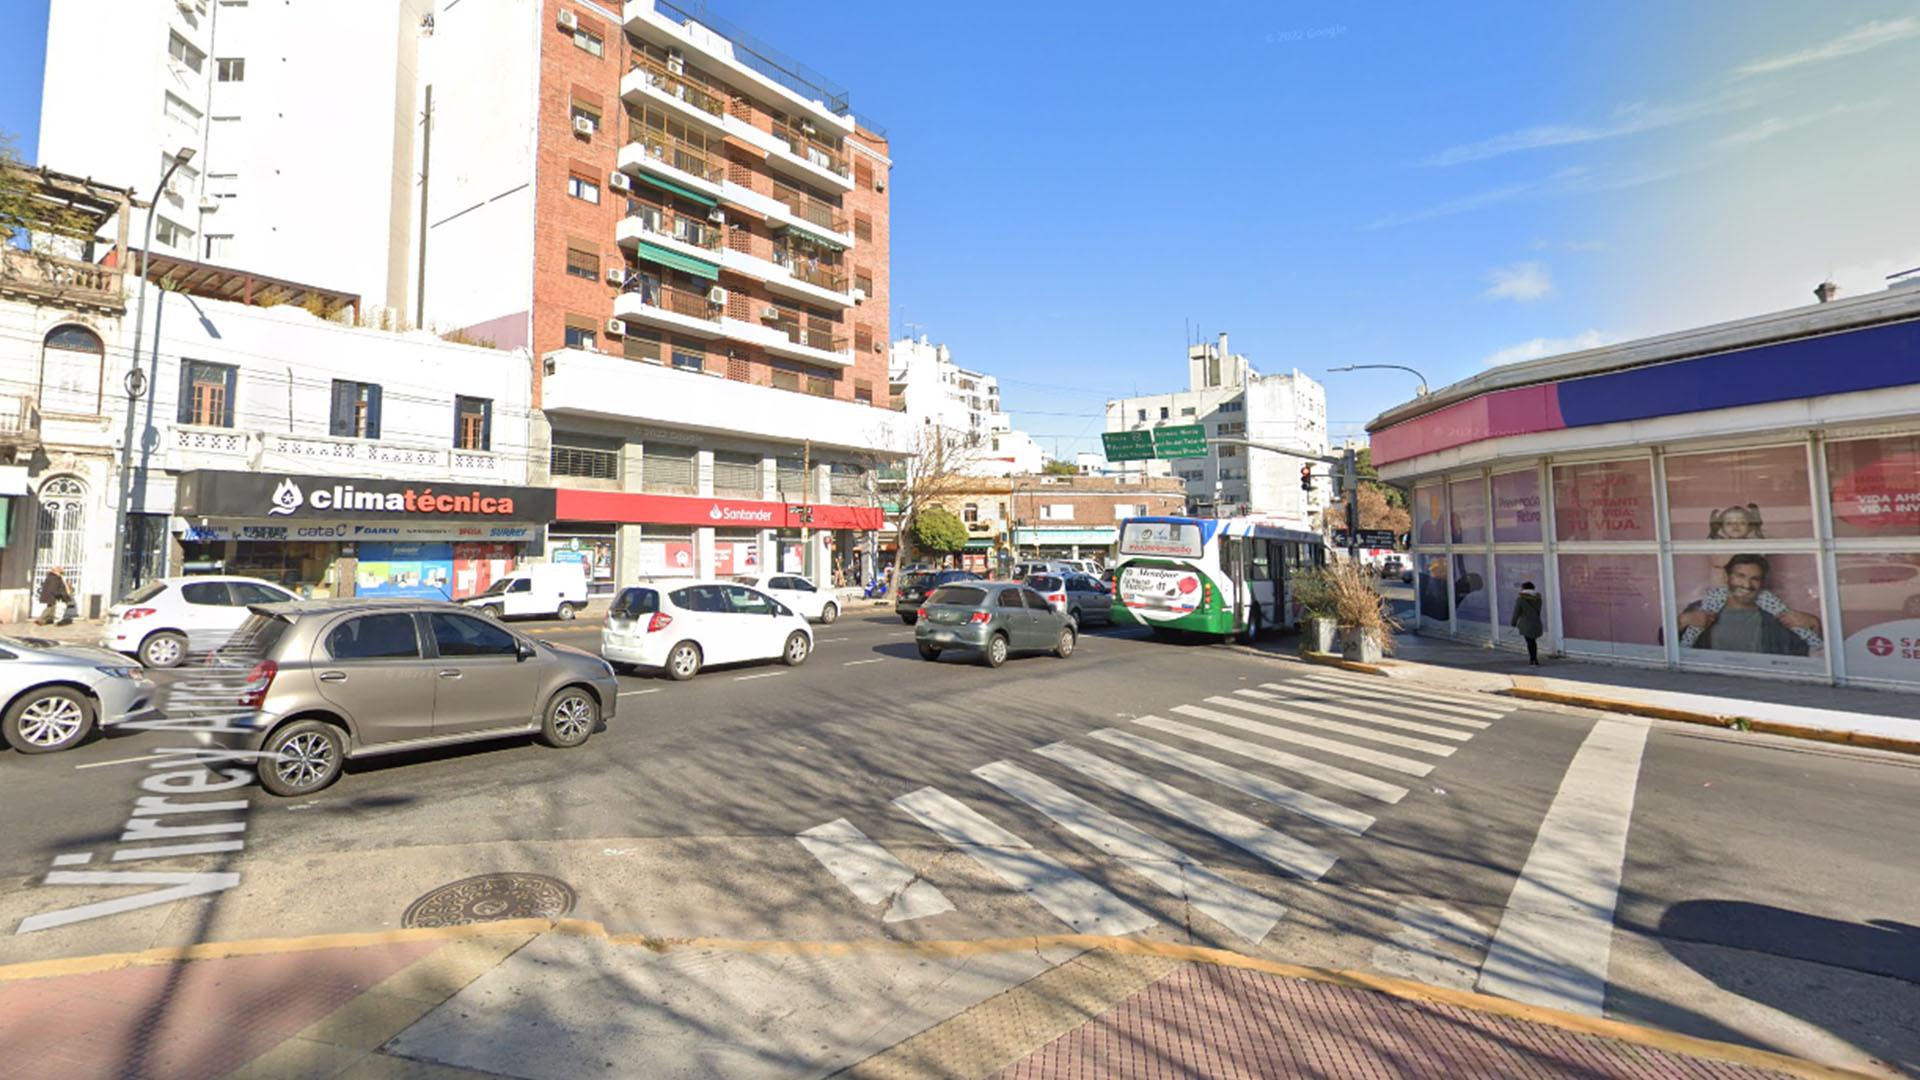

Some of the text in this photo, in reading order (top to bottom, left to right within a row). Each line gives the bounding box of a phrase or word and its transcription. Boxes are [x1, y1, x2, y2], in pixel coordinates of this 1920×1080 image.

[309, 485, 514, 515] climatécnica
[1857, 495, 1891, 503] VIDA
[723, 507, 773, 521] Santander
[1857, 505, 1892, 513] VIDA
[297, 525, 335, 537] cata
[363, 527, 400, 535] DAIKIN
[1568, 519, 1641, 533] TU VIDA.
